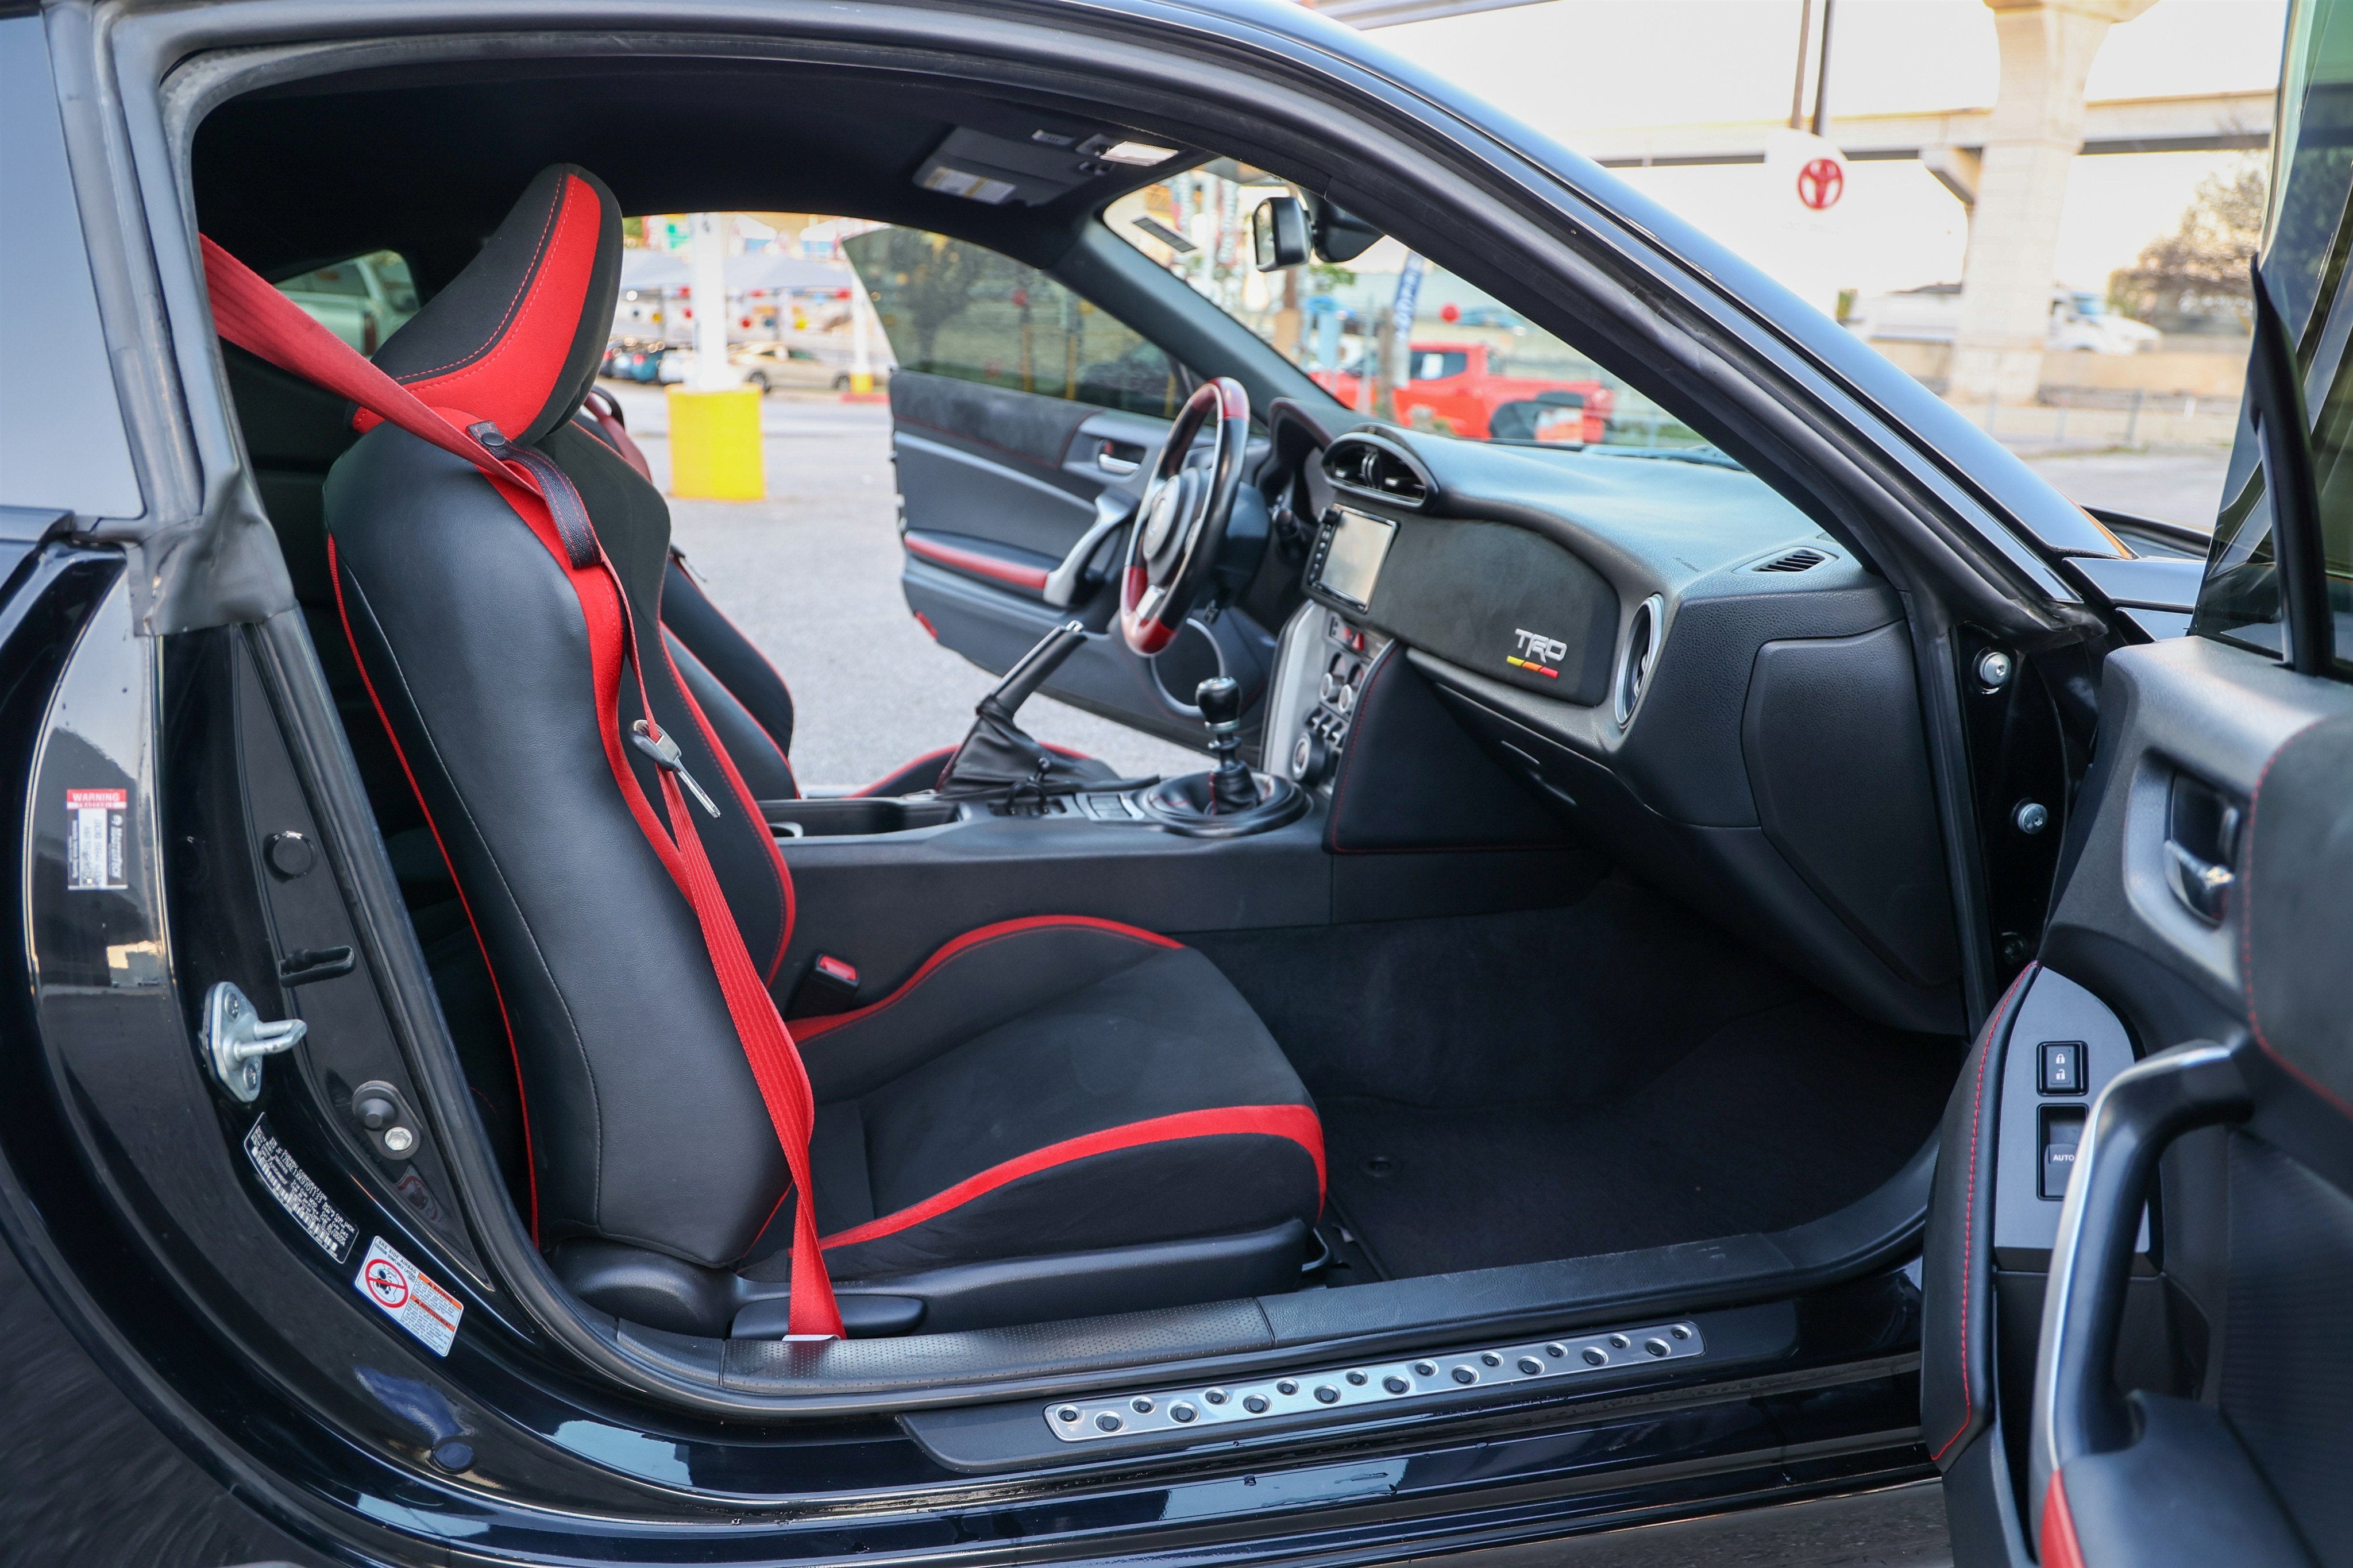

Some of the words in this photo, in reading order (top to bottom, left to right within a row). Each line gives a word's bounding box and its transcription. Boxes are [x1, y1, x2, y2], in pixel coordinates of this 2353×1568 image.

[1515, 628, 1567, 663] TRD
[72, 793, 120, 801] WARNING
[284, 1149, 298, 1168] SUBARU
[299, 1169, 327, 1200] CORPORATION
[377, 1239, 388, 1250] SRS
[388, 1249, 399, 1260] SIDE
[400, 1258, 416, 1274] AIRBAG
[433, 1285, 453, 1303] WARNING
